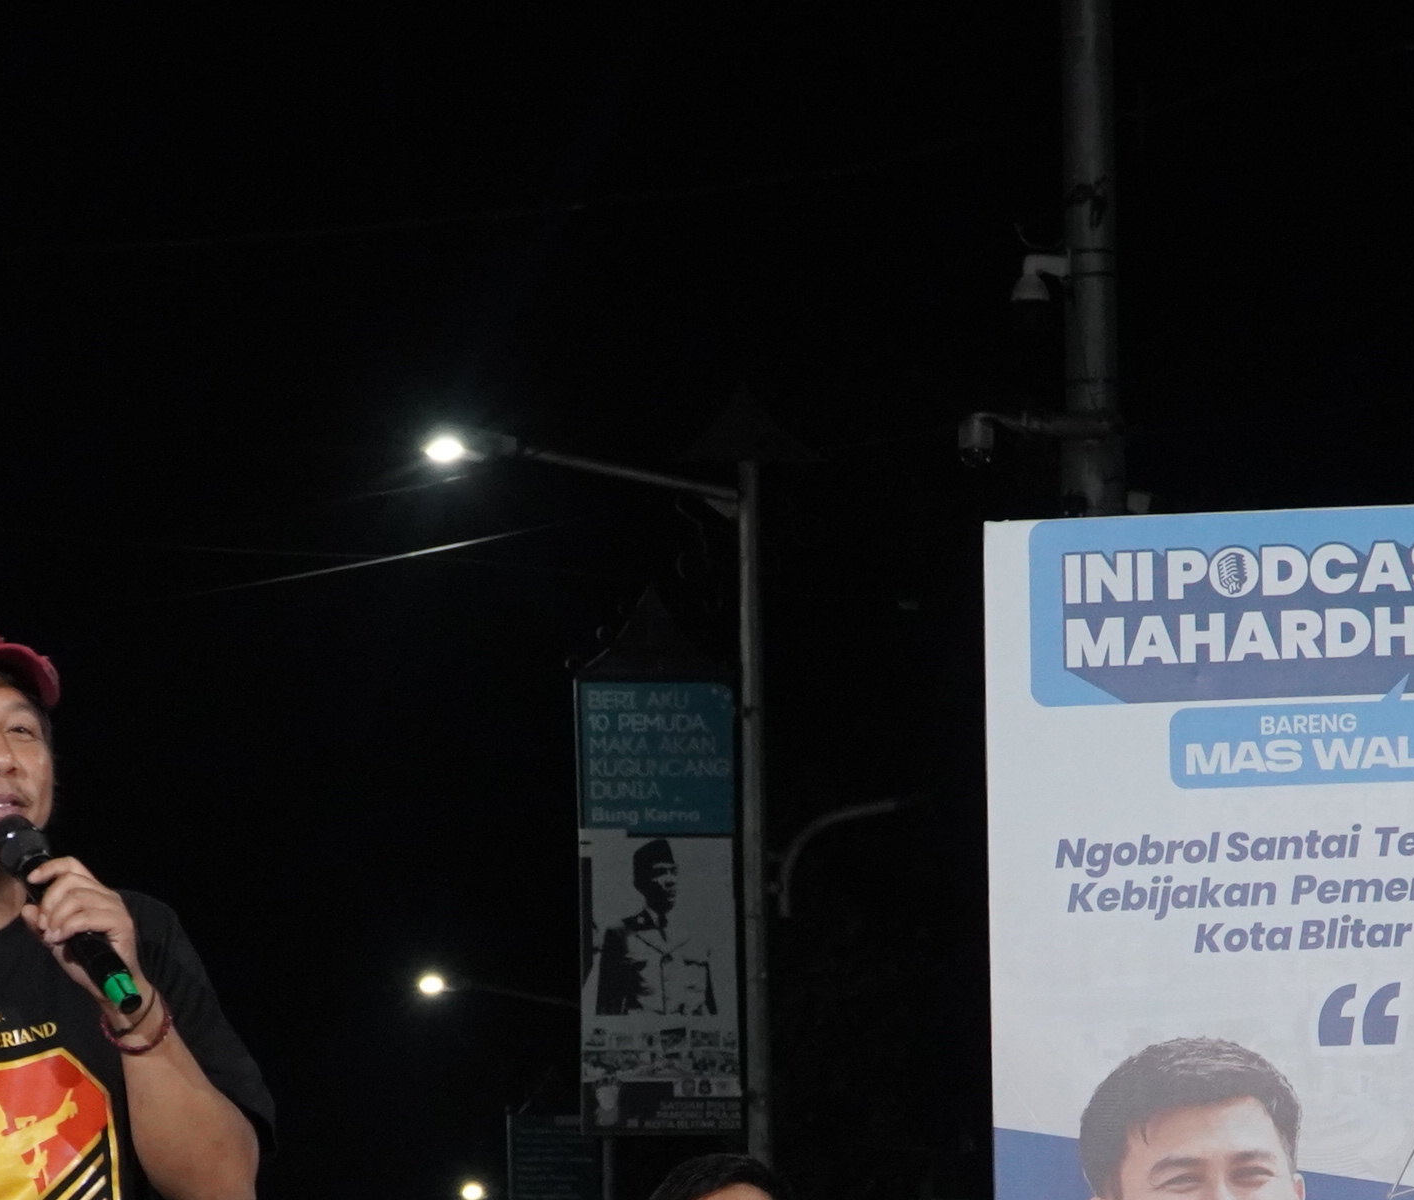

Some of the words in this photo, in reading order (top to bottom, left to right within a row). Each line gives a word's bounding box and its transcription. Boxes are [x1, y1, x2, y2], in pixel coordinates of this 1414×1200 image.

[1064, 551, 1154, 604] INI
[587, 690, 636, 710] BERI
[647, 691, 689, 708] AKU
[588, 713, 609, 732] 10
[1260, 713, 1357, 736] BARENG
[589, 736, 649, 754] MAKA
[659, 736, 716, 754] AKAN
[1187, 739, 1302, 776] MAS
[590, 781, 662, 800] DUNIA
[592, 808, 639, 825] Bung
[645, 808, 700, 823] Karno
[1055, 831, 1220, 878] Ngobrol
[1225, 824, 1360, 862] Santai
[1067, 876, 1277, 920] Kebijakan
[1193, 921, 1292, 953] Kota
[1299, 915, 1412, 951] Blitar
